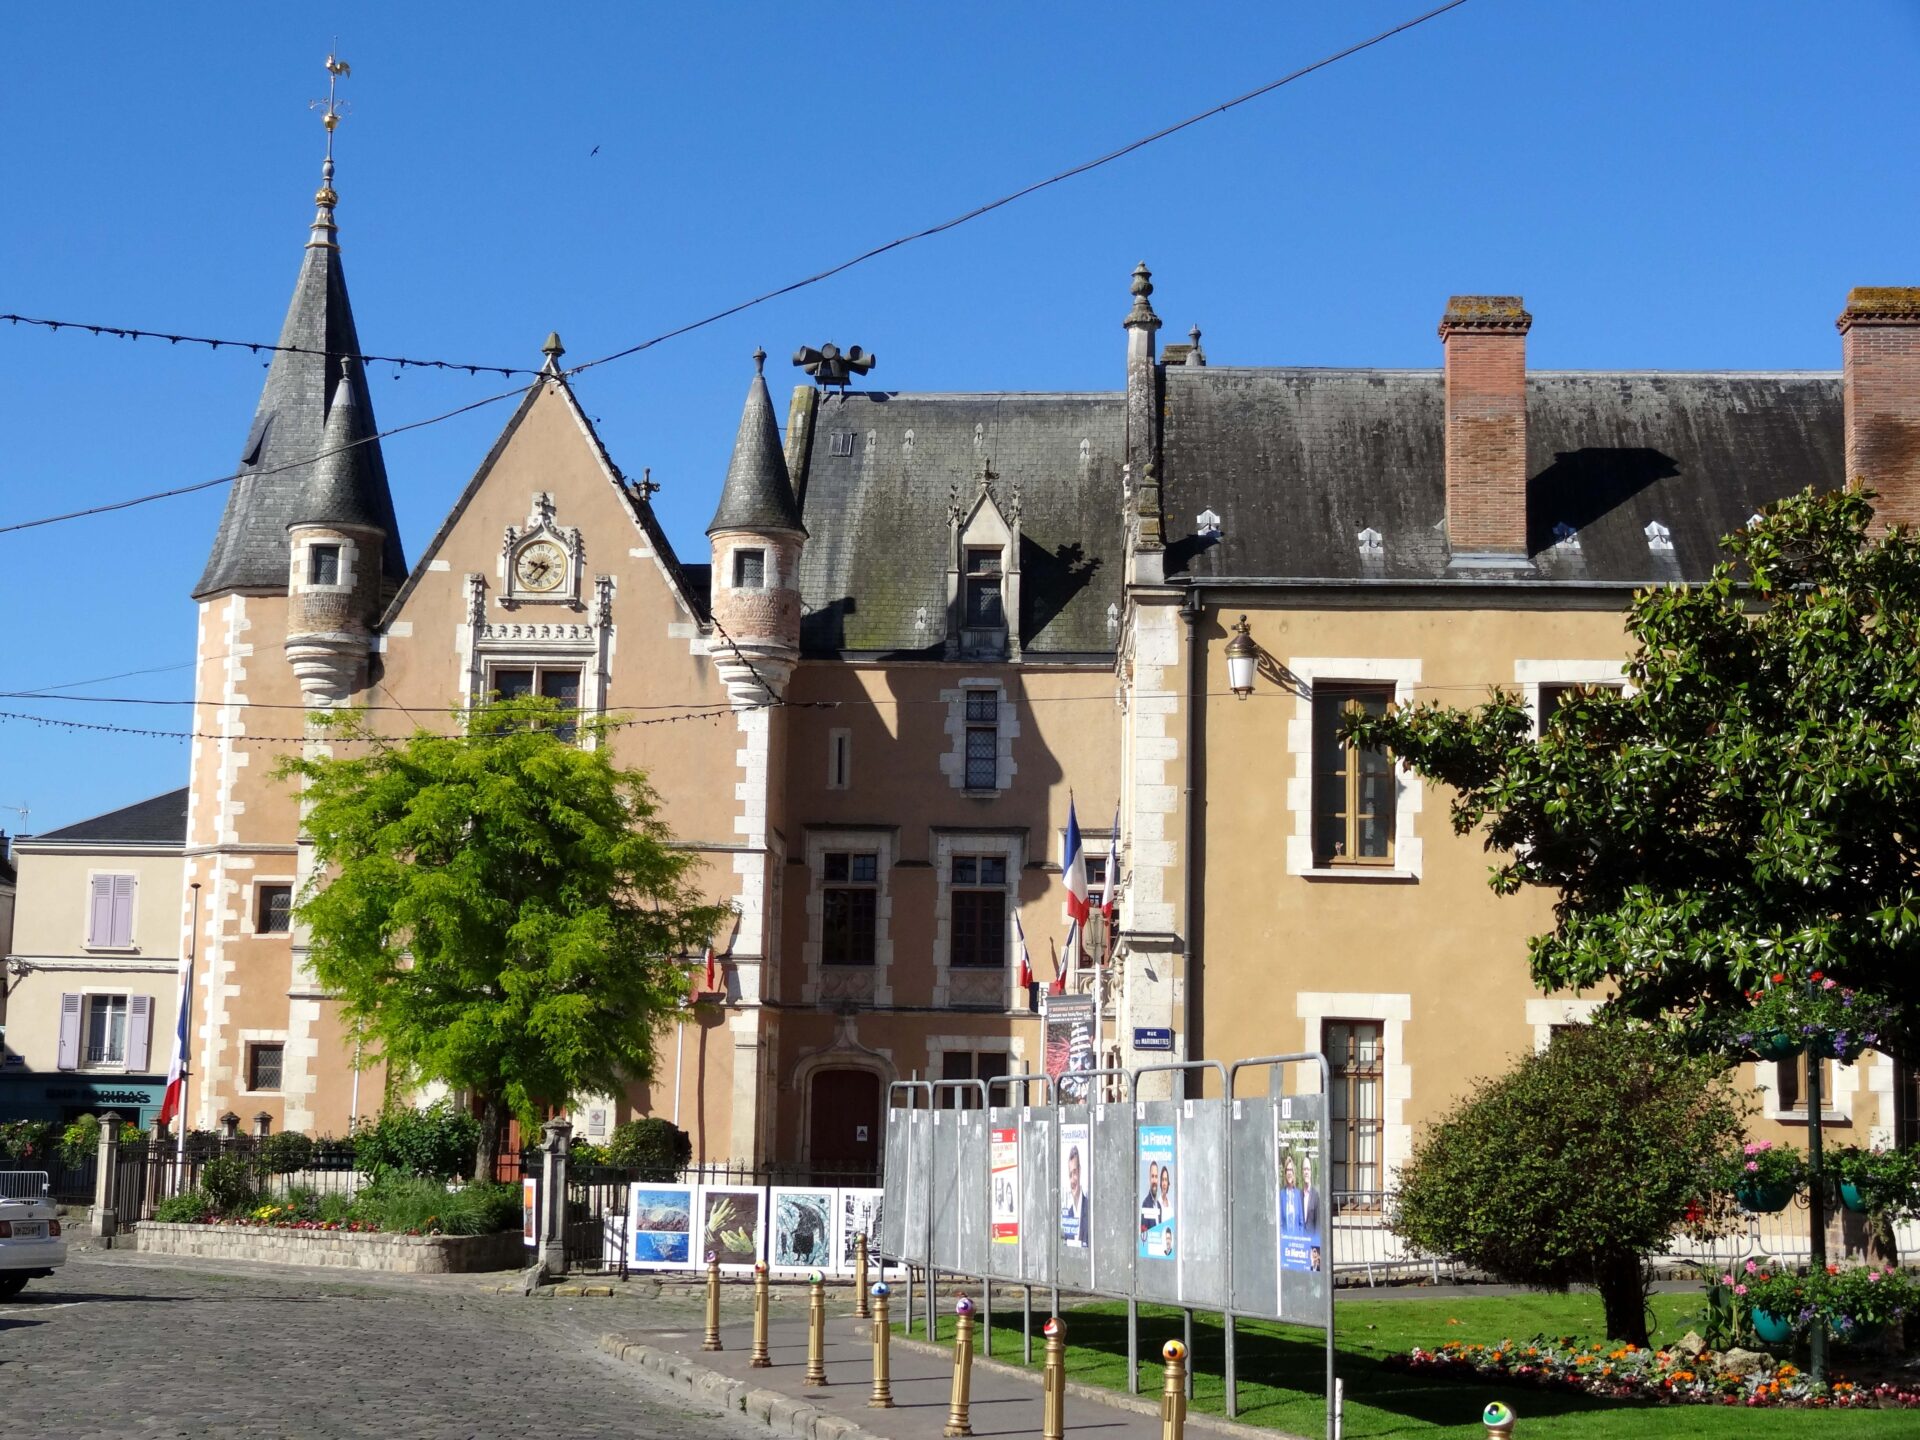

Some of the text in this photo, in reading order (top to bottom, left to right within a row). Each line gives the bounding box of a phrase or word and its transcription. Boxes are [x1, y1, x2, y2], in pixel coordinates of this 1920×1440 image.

[46, 1089, 145, 1100] BNP PARIBAS
[1141, 1132, 1172, 1146] La France
[1291, 1248, 1306, 1259] Marche
